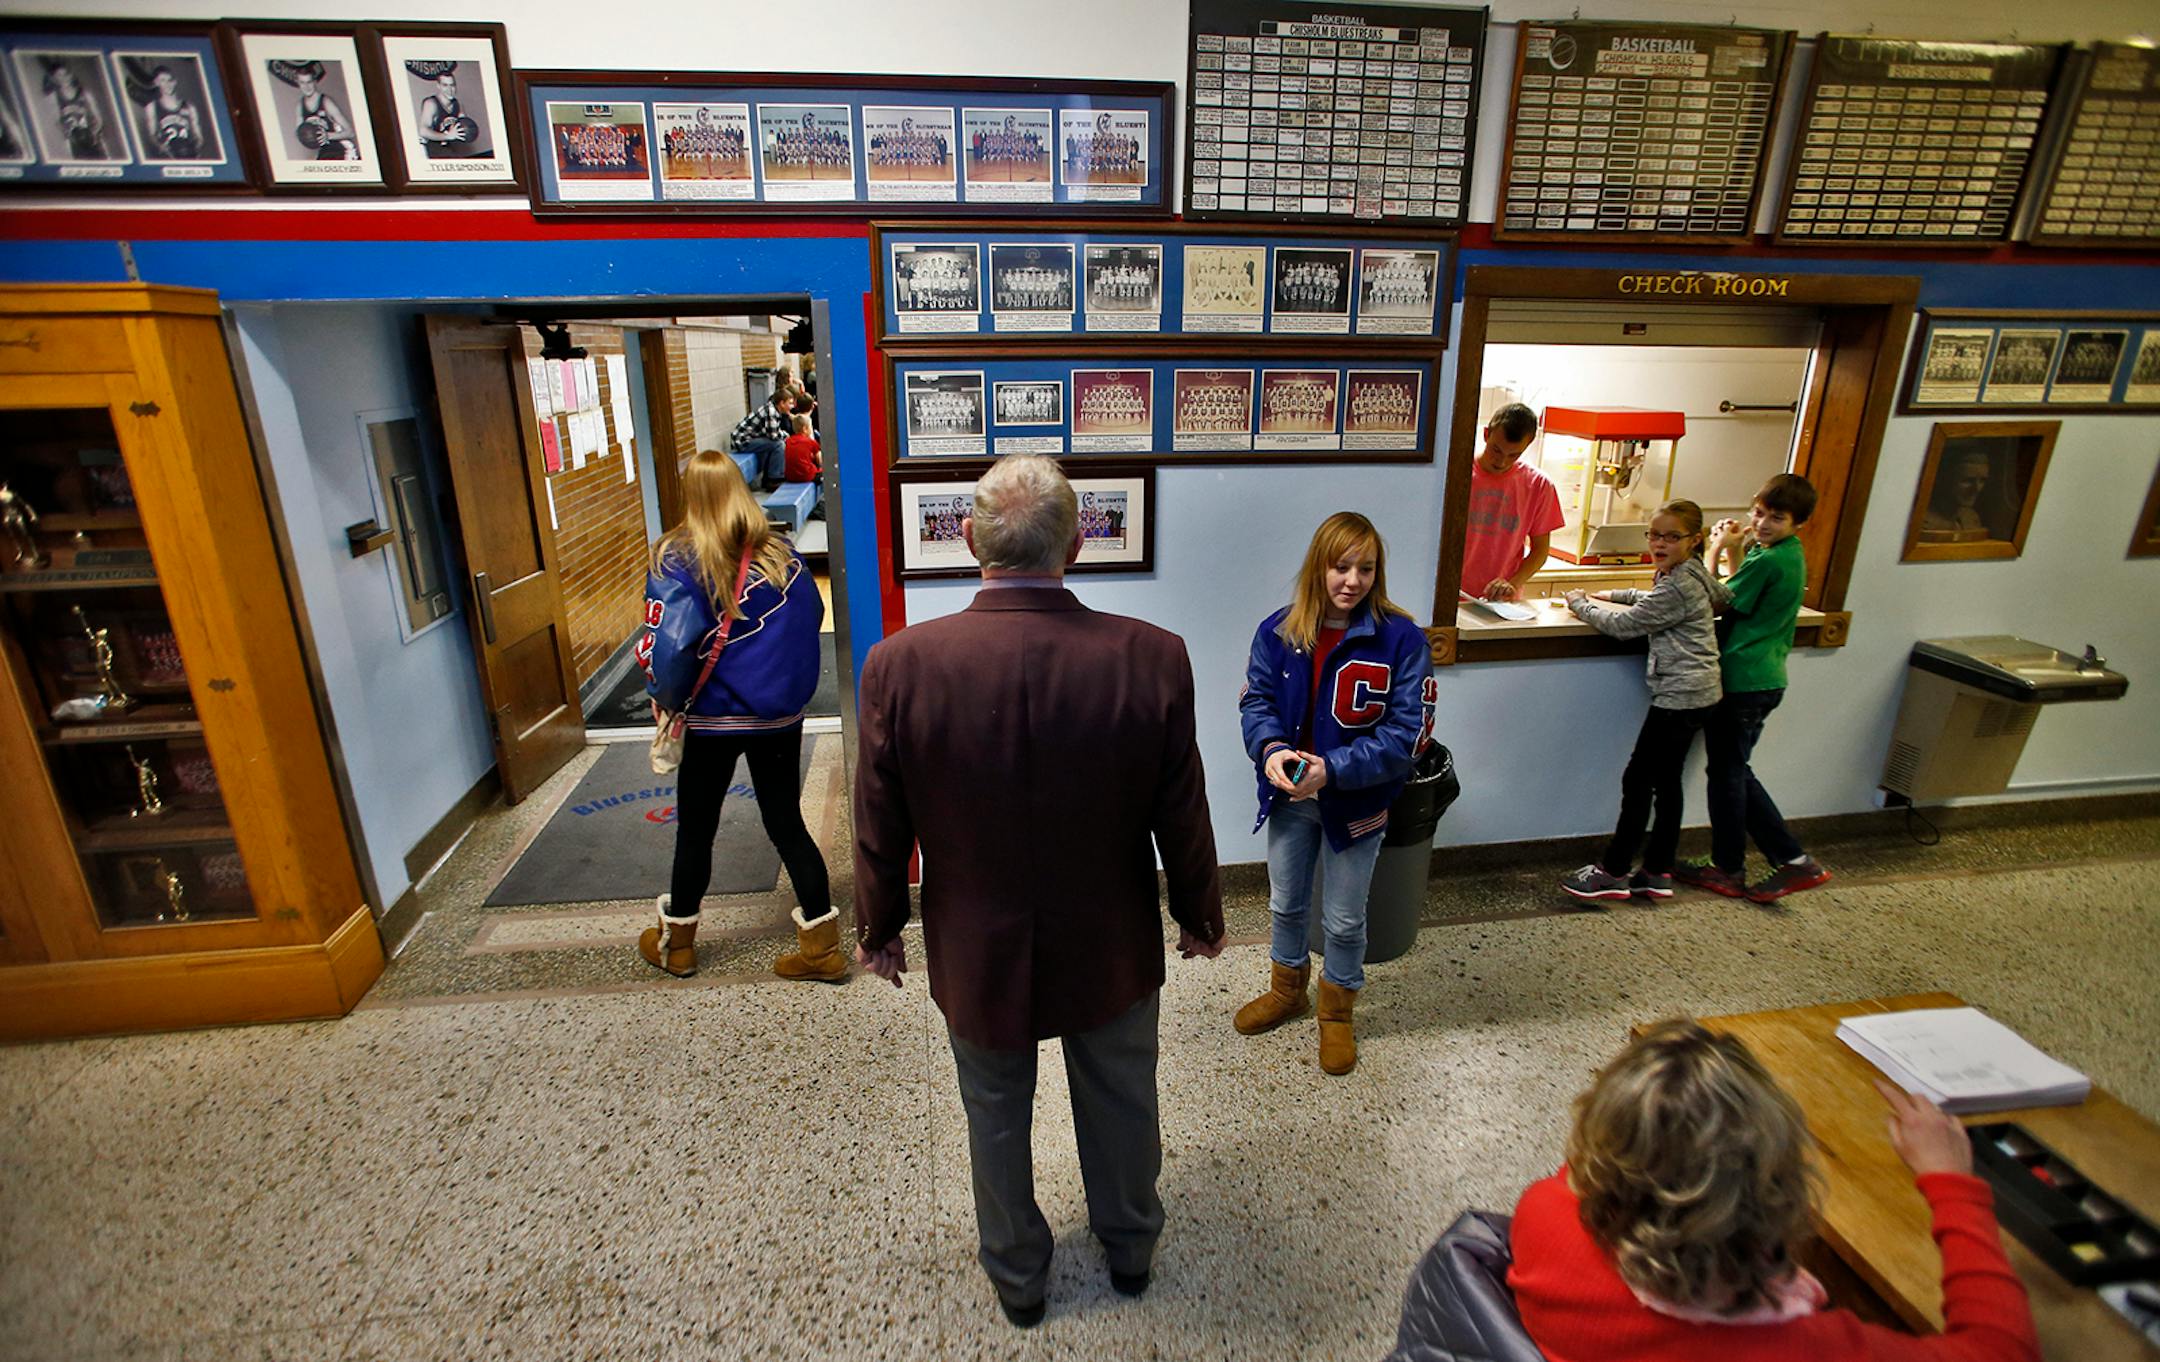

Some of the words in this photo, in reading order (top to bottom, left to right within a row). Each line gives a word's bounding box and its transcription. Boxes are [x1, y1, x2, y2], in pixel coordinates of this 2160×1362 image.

[1312, 13, 1366, 26] BASKETBALL
[1290, 23, 1329, 38] CHISHOLM
[1330, 26, 1384, 40] BLUESTREAKS
[1611, 36, 1697, 54] BASKETBALL
[1603, 52, 1648, 65] CHISHOLM
[1666, 54, 1695, 67] GIRLS
[1913, 47, 1975, 63] RECORDS
[430, 163, 456, 172] TYLER
[1617, 275, 1705, 295] CHECK
[1713, 273, 1790, 297] ROOM
[1331, 659, 1391, 729] C
[570, 785, 678, 817] Bluestr
